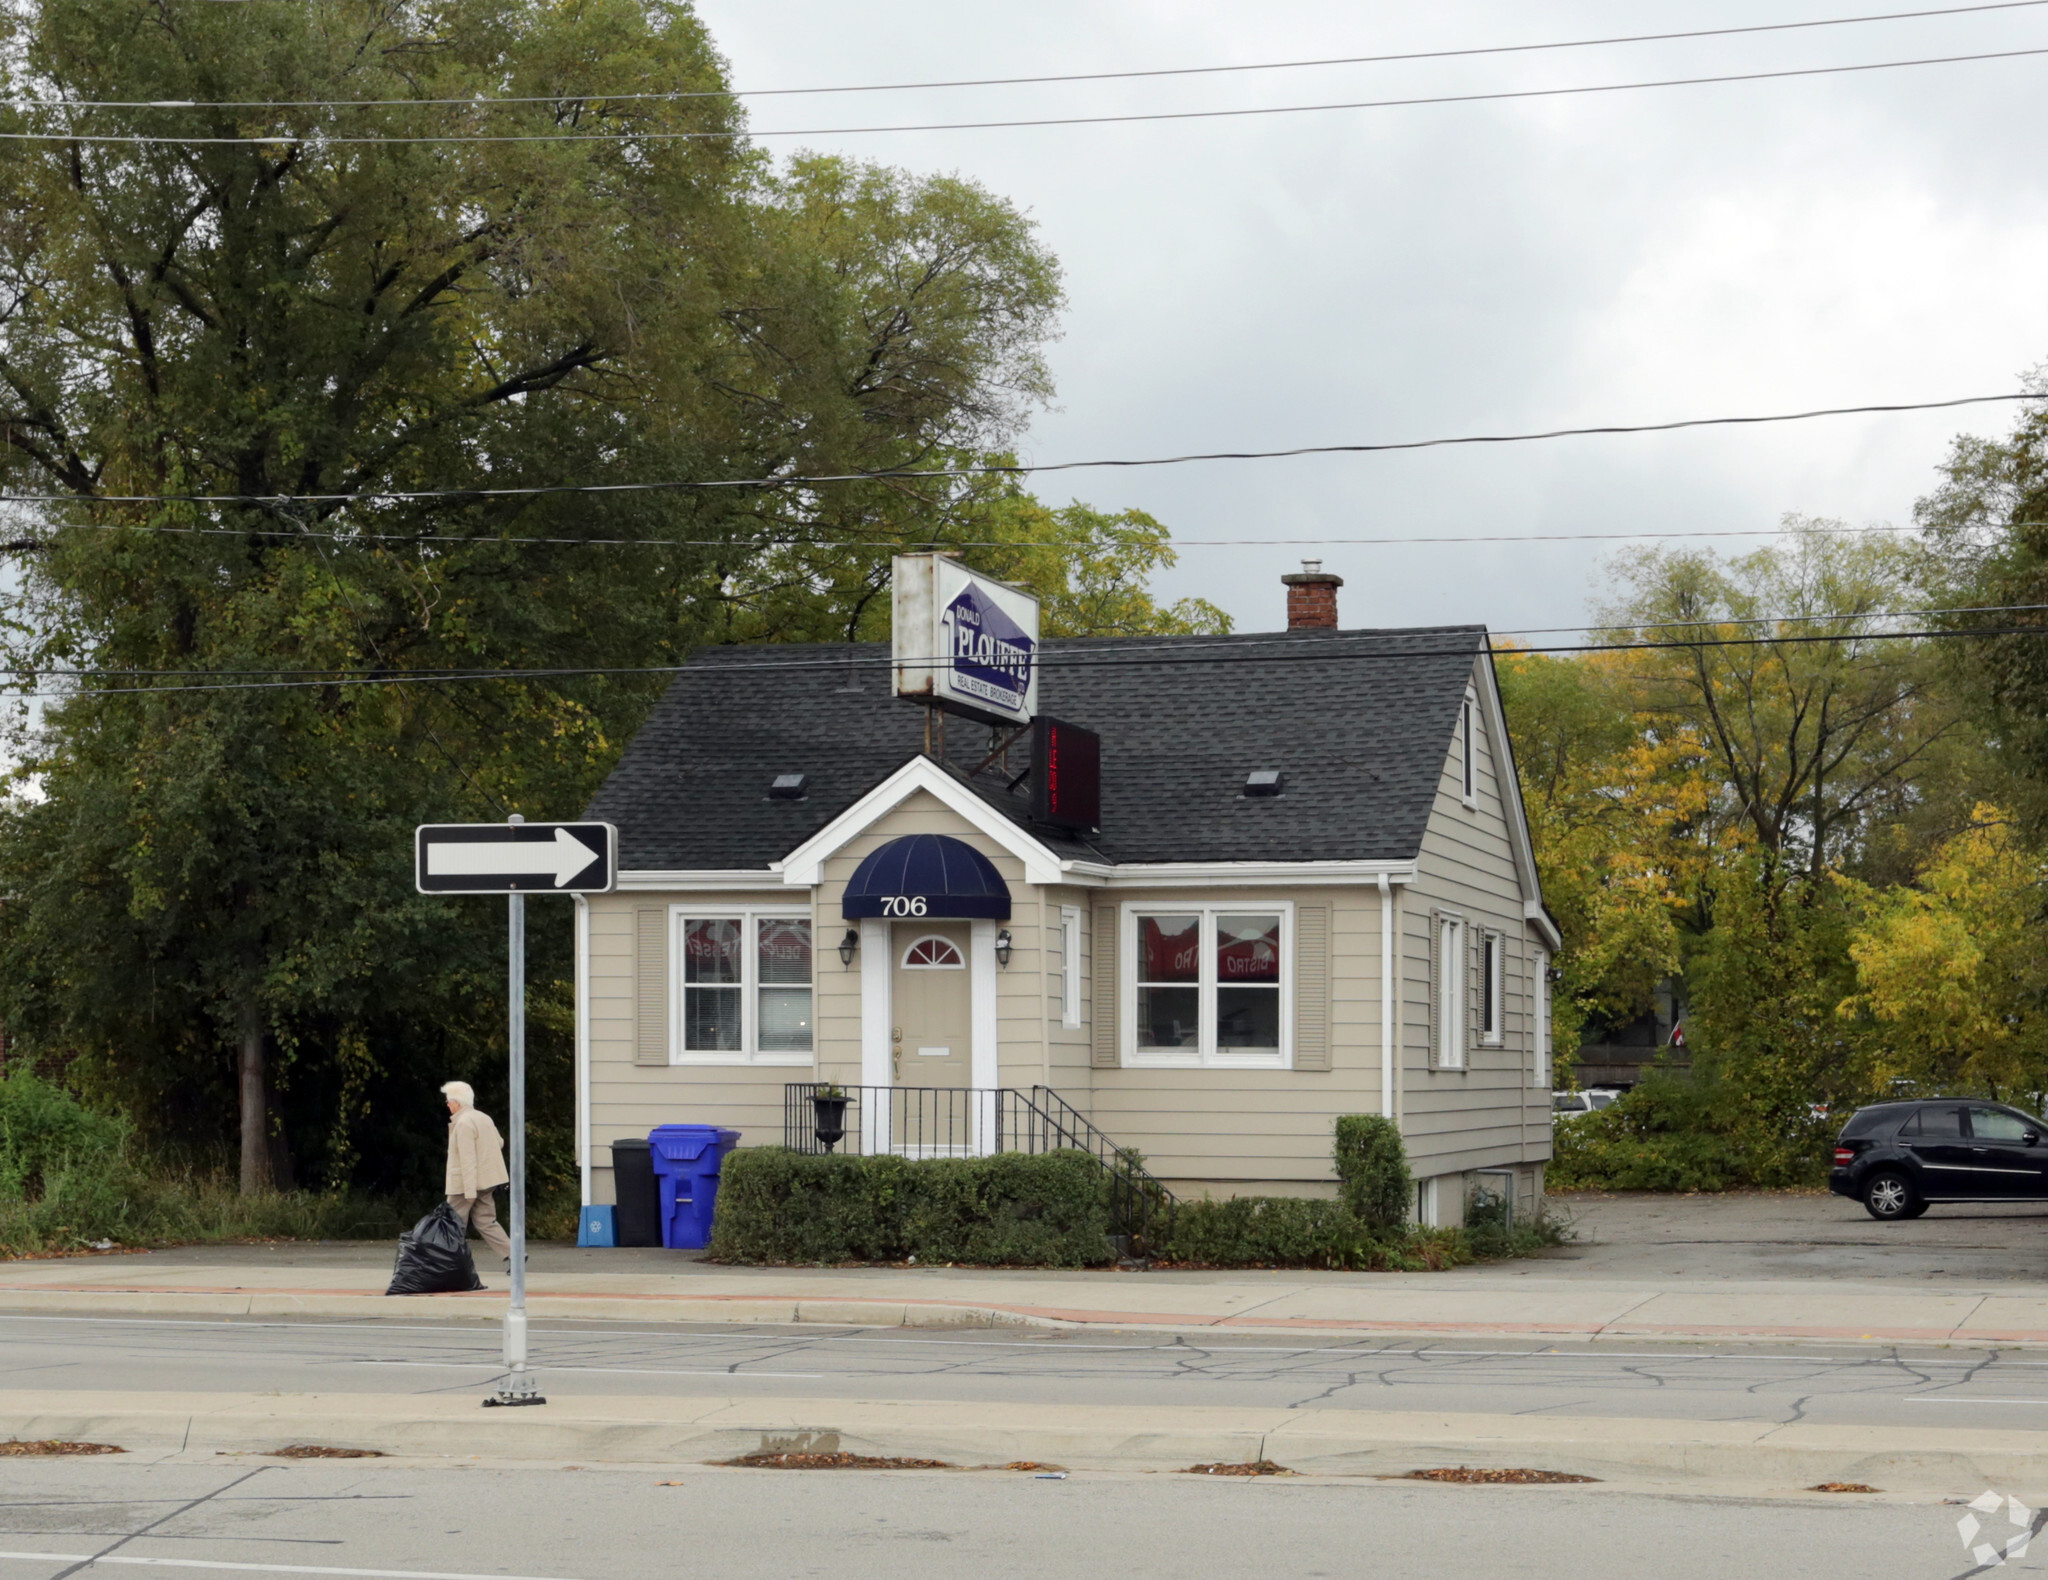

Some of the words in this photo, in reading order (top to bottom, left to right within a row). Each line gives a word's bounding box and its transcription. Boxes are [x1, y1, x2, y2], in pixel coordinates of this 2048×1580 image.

[956, 604, 980, 627] DONALD
[958, 625, 1027, 681] PLOUFFE
[957, 674, 970, 690] REAL
[970, 679, 988, 696] ESTATE
[990, 686, 1017, 706] BROKERAGE
[880, 896, 928, 917] 706
